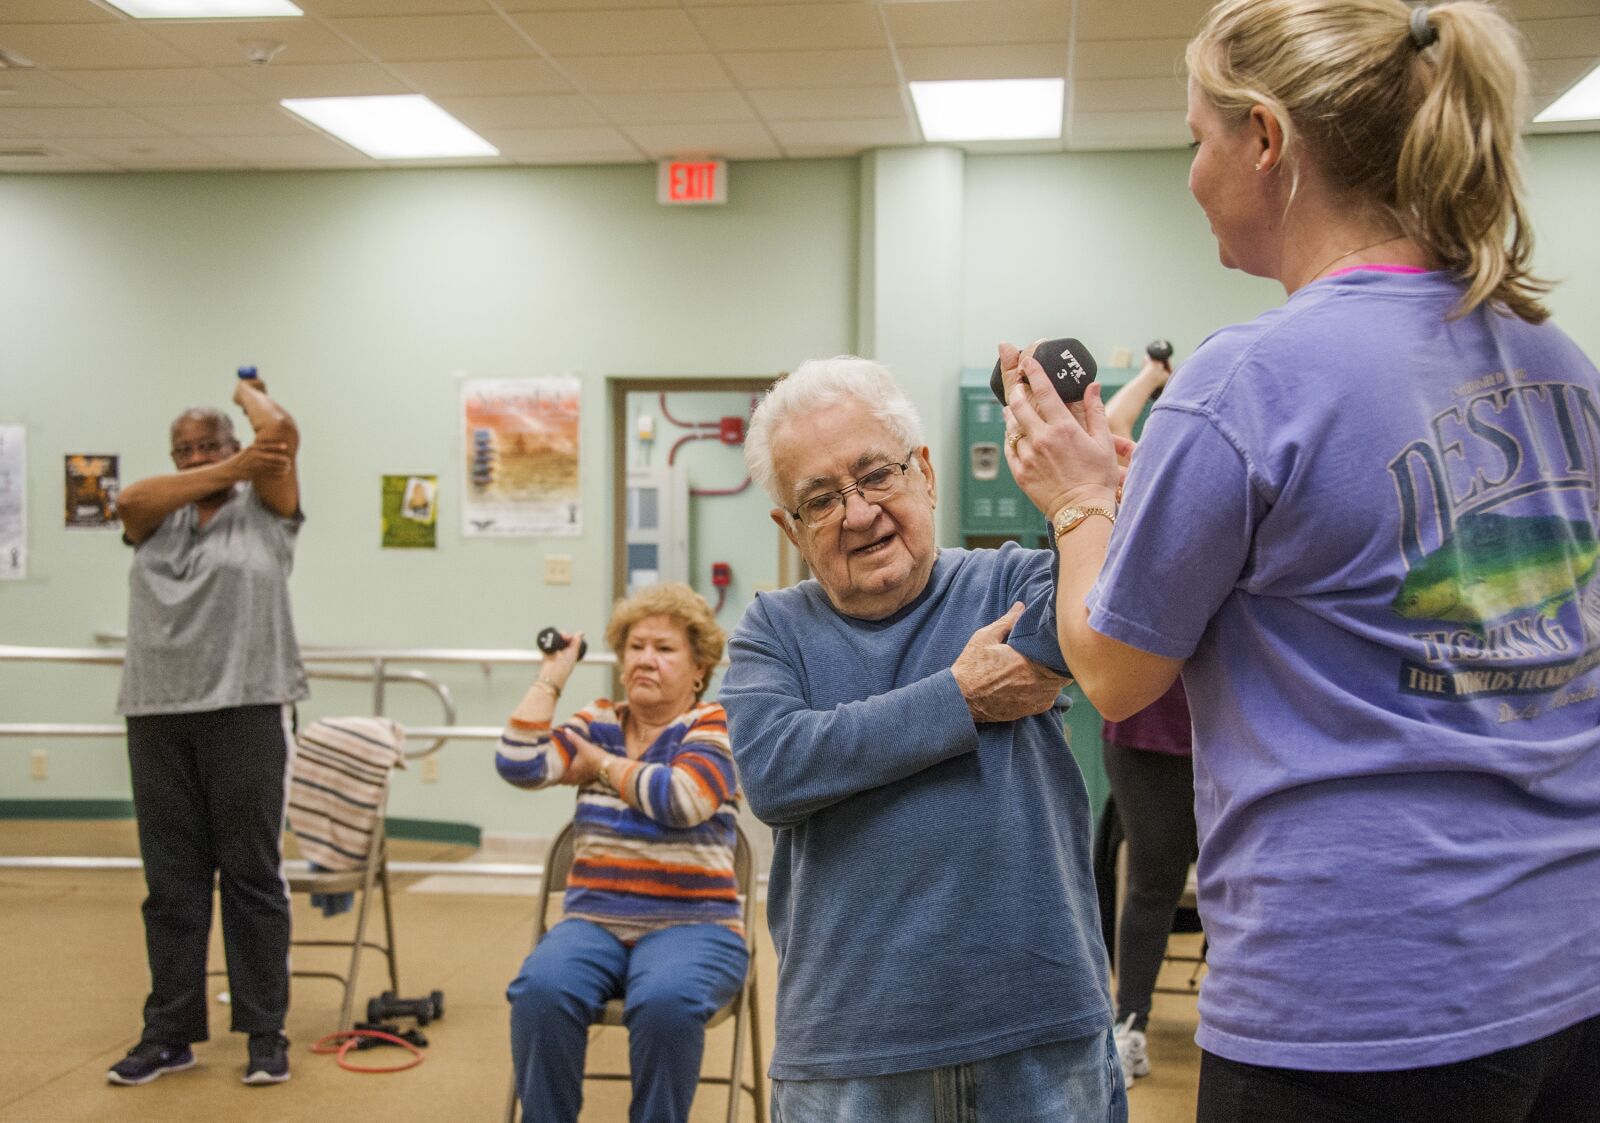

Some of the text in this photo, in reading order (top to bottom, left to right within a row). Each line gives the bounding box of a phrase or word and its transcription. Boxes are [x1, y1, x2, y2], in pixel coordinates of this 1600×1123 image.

[669, 161, 717, 200] EXIT
[1057, 369, 1067, 379] 3
[1060, 349, 1086, 378] VTX
[1407, 667, 1446, 693] THE
